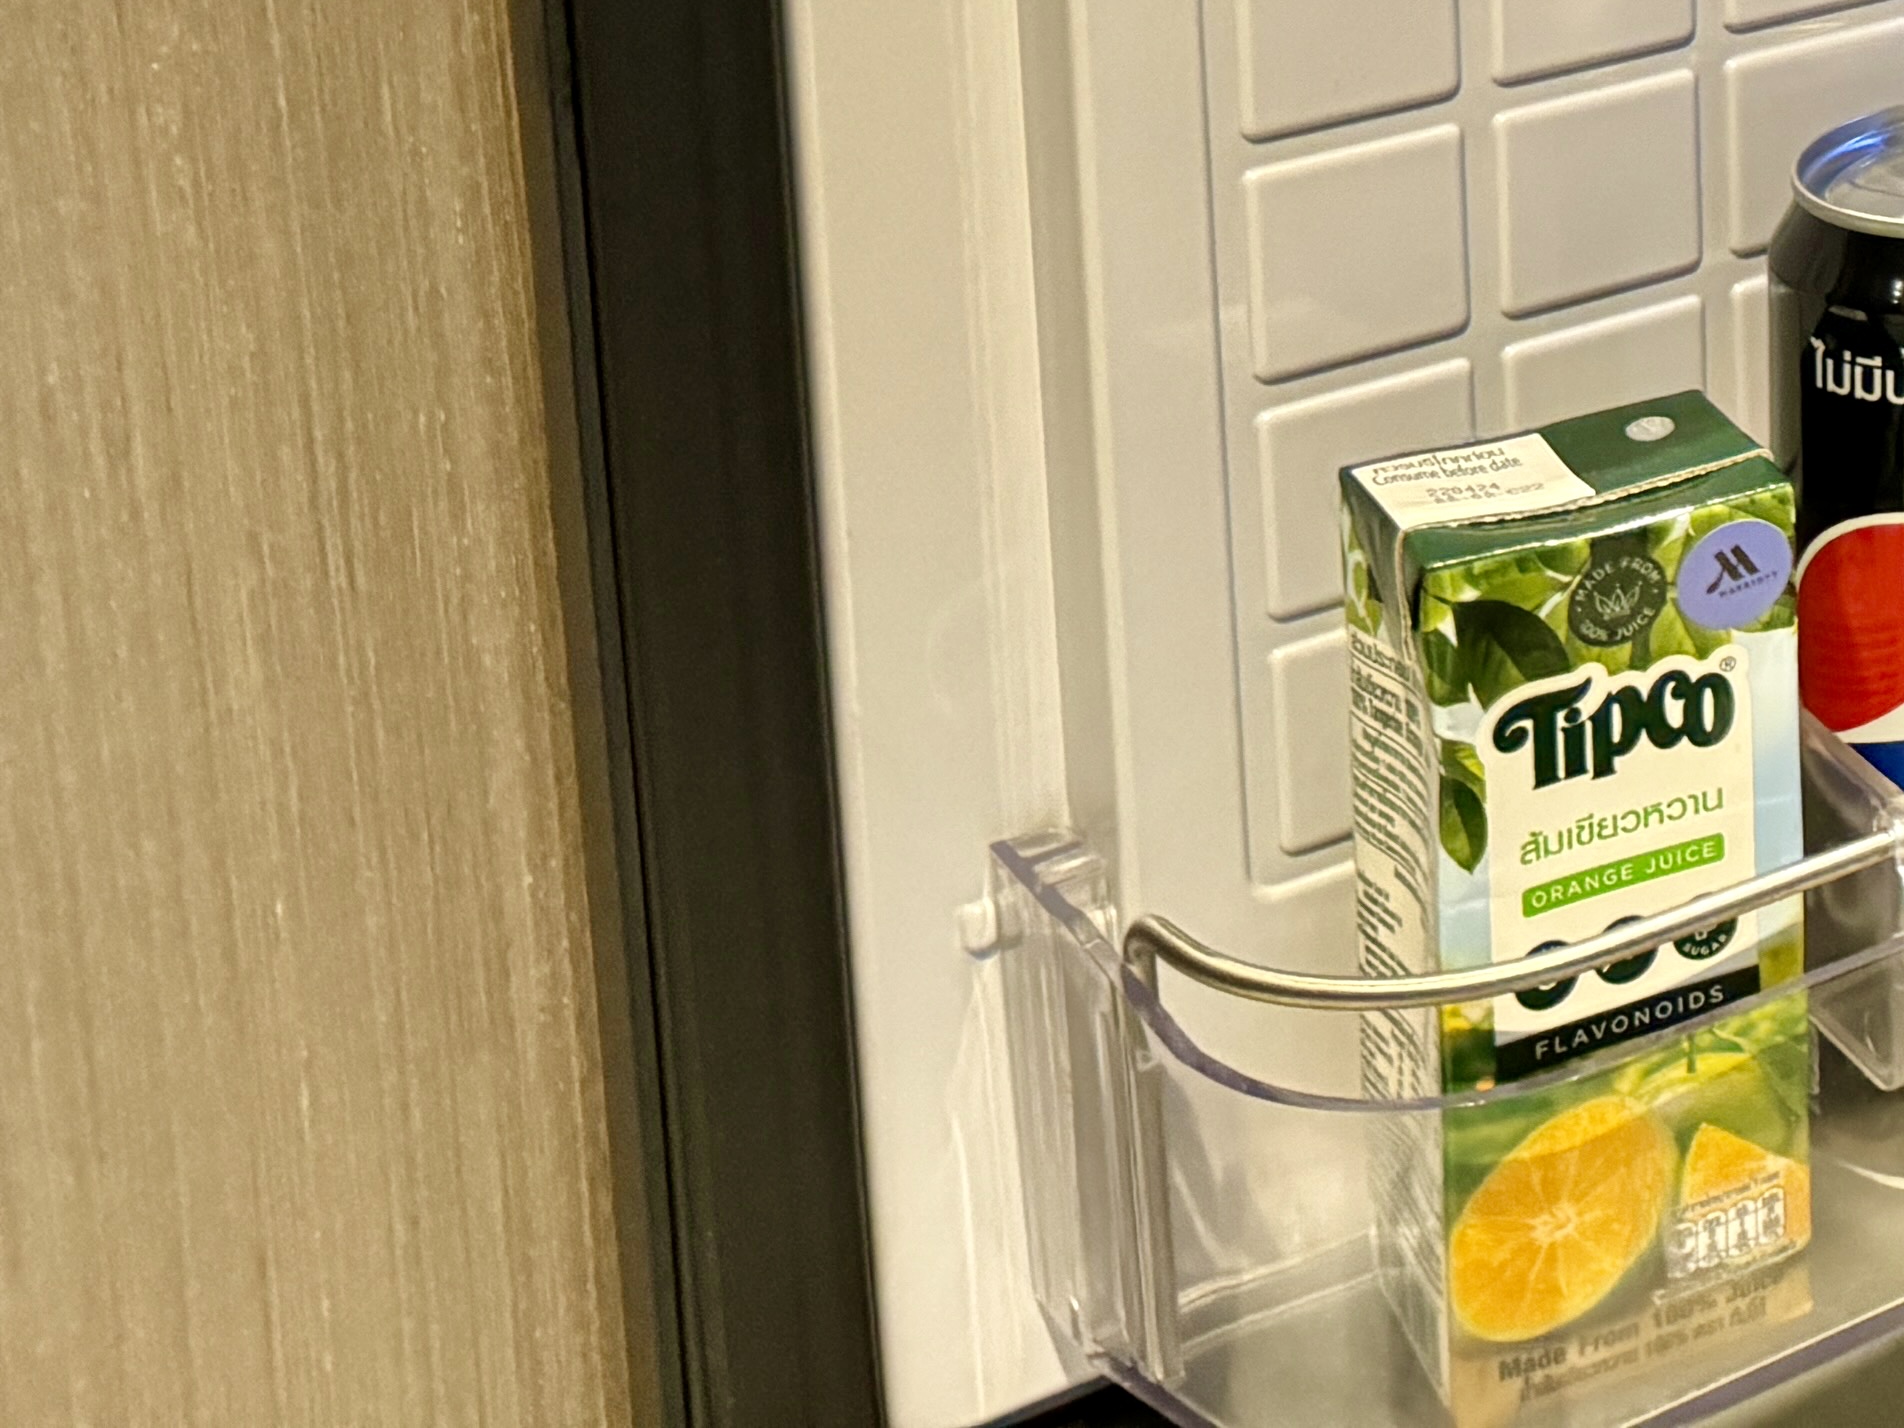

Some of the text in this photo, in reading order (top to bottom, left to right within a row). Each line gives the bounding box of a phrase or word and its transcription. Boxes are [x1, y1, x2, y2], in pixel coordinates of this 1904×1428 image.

[1371, 456, 1523, 486] Consume before date
[1574, 555, 1663, 602] MADE FROM
[1615, 605, 1656, 642] JUICE
[1492, 669, 1736, 791] Tipco
[1519, 786, 1725, 867] ส้มเขียวหวาน
[1531, 839, 1719, 909] ORANGE JUICE
[1681, 933, 1728, 957] SUGAR
[1535, 984, 1725, 1061] FLAVONOIDS
[1497, 1344, 1568, 1383] Made
